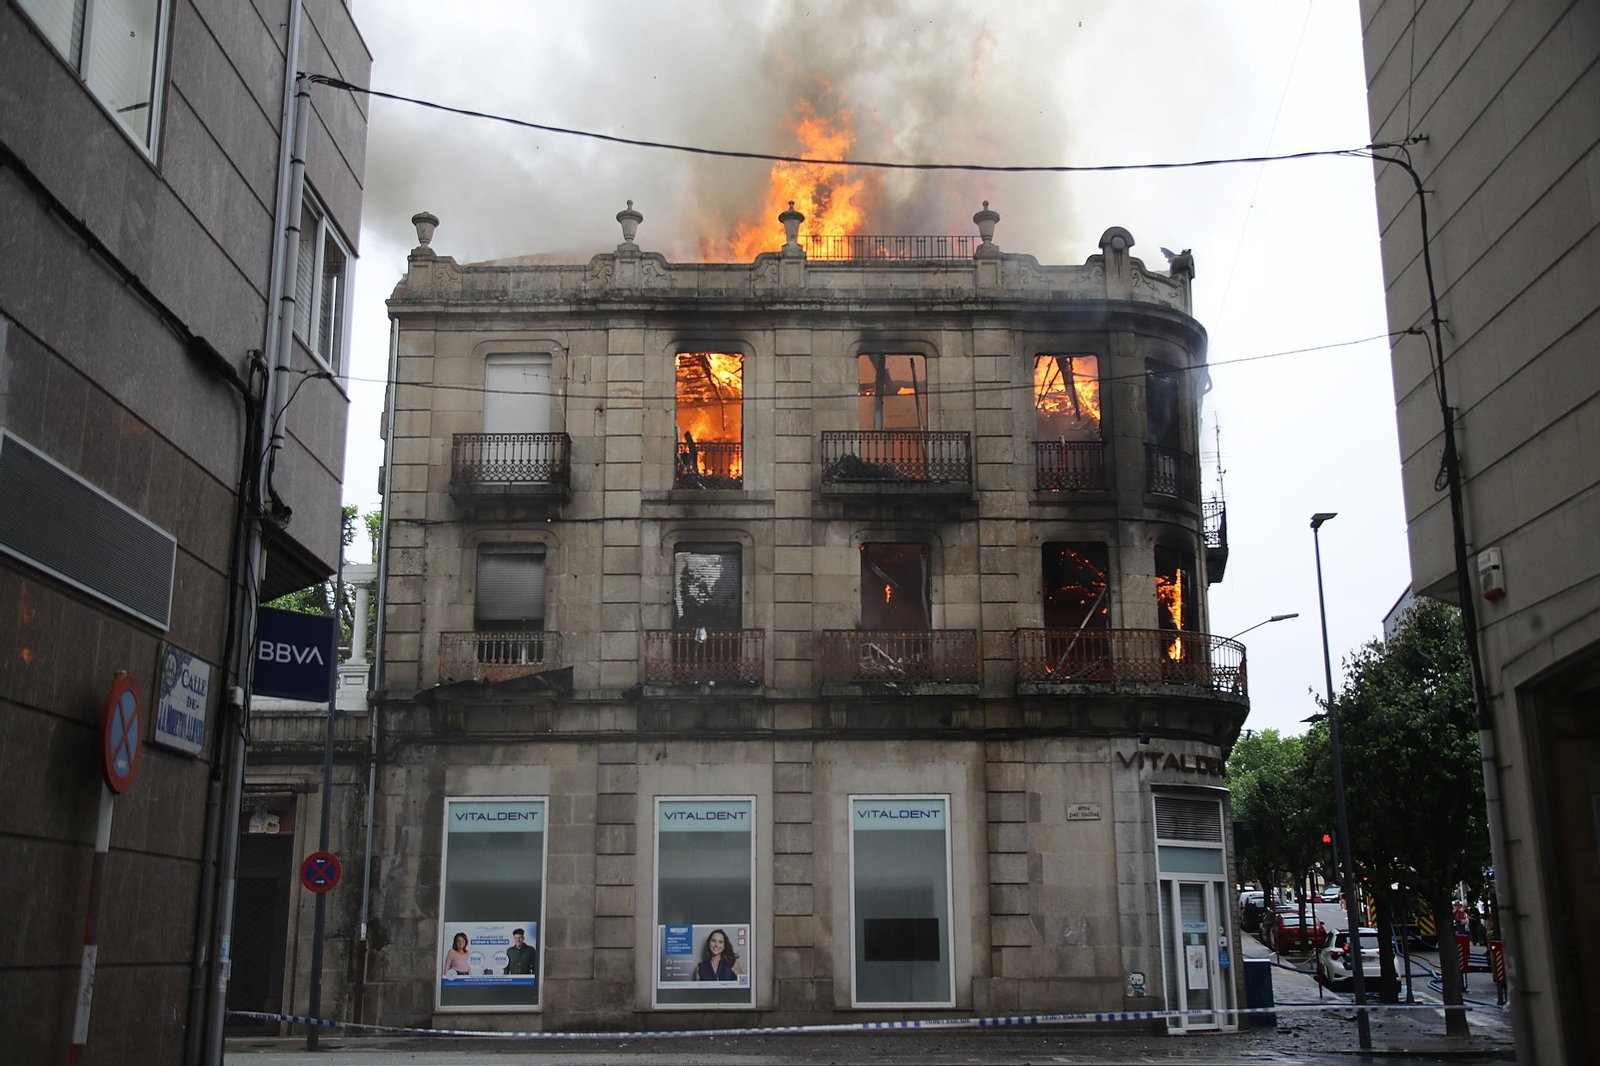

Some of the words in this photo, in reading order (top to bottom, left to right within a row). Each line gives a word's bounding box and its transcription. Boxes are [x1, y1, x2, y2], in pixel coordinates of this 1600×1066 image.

[258, 640, 324, 666] BBVA
[181, 669, 207, 697] CALLE
[455, 811, 539, 821] VITALDENT
[664, 811, 747, 820] VITALDENT
[857, 810, 940, 819] VITALDENT
